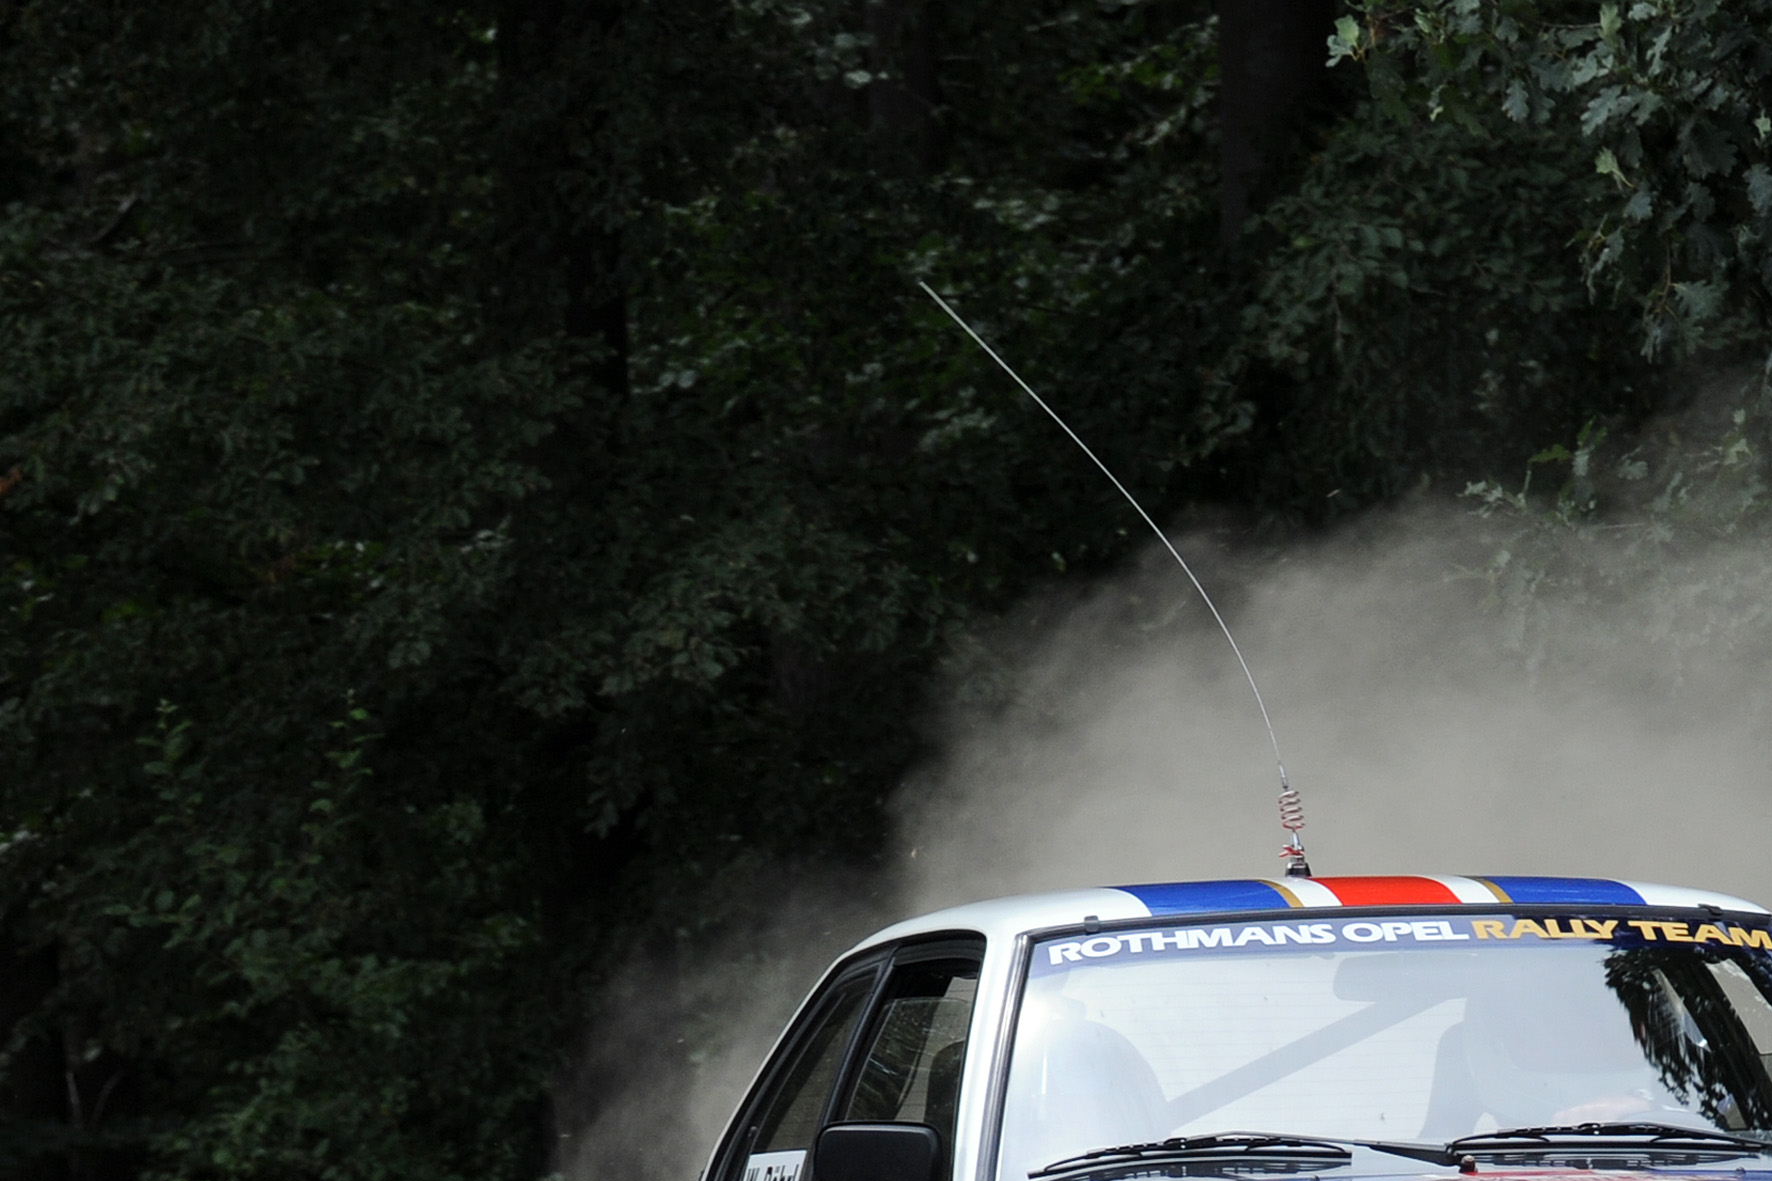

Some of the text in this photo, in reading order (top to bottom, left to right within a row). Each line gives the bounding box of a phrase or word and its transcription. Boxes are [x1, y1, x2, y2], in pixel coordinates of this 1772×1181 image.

[1049, 923, 1336, 965] ROTHMANS
[1342, 920, 1469, 943] OPEL
[1471, 918, 1618, 940] RALLY
